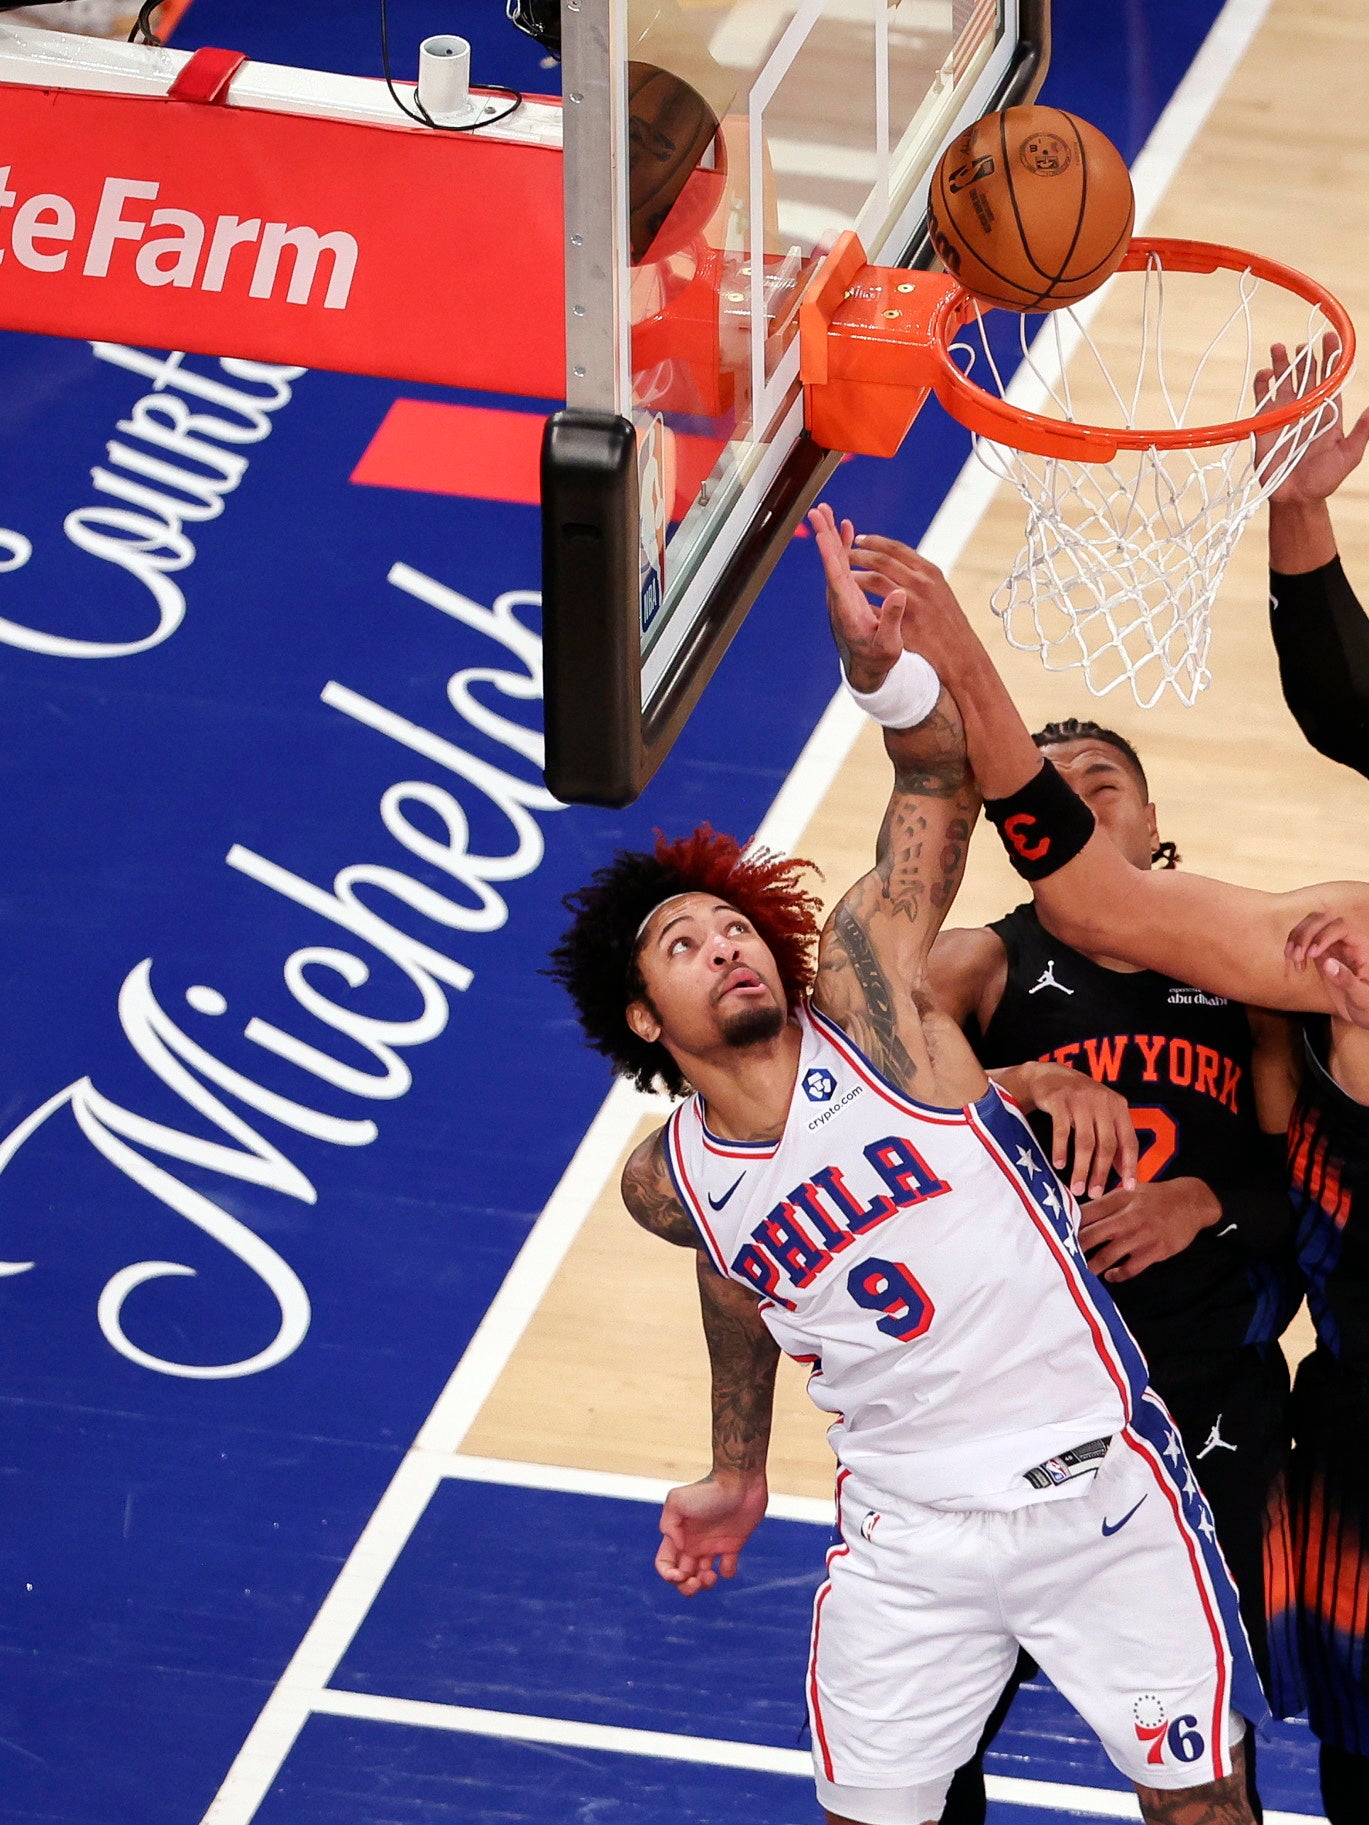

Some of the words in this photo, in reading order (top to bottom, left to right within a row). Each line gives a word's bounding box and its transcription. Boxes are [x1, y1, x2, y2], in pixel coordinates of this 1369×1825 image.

[0, 341, 308, 659] Court
[1167, 993, 1193, 1004] abu
[808, 1085, 864, 1130] crypto.com
[1038, 1034, 1128, 1083] EW
[1134, 1034, 1243, 1115] YORK
[731, 1135, 953, 1312] PHILA
[847, 1256, 936, 1343] 9
[1134, 1713, 1205, 1765] 76
